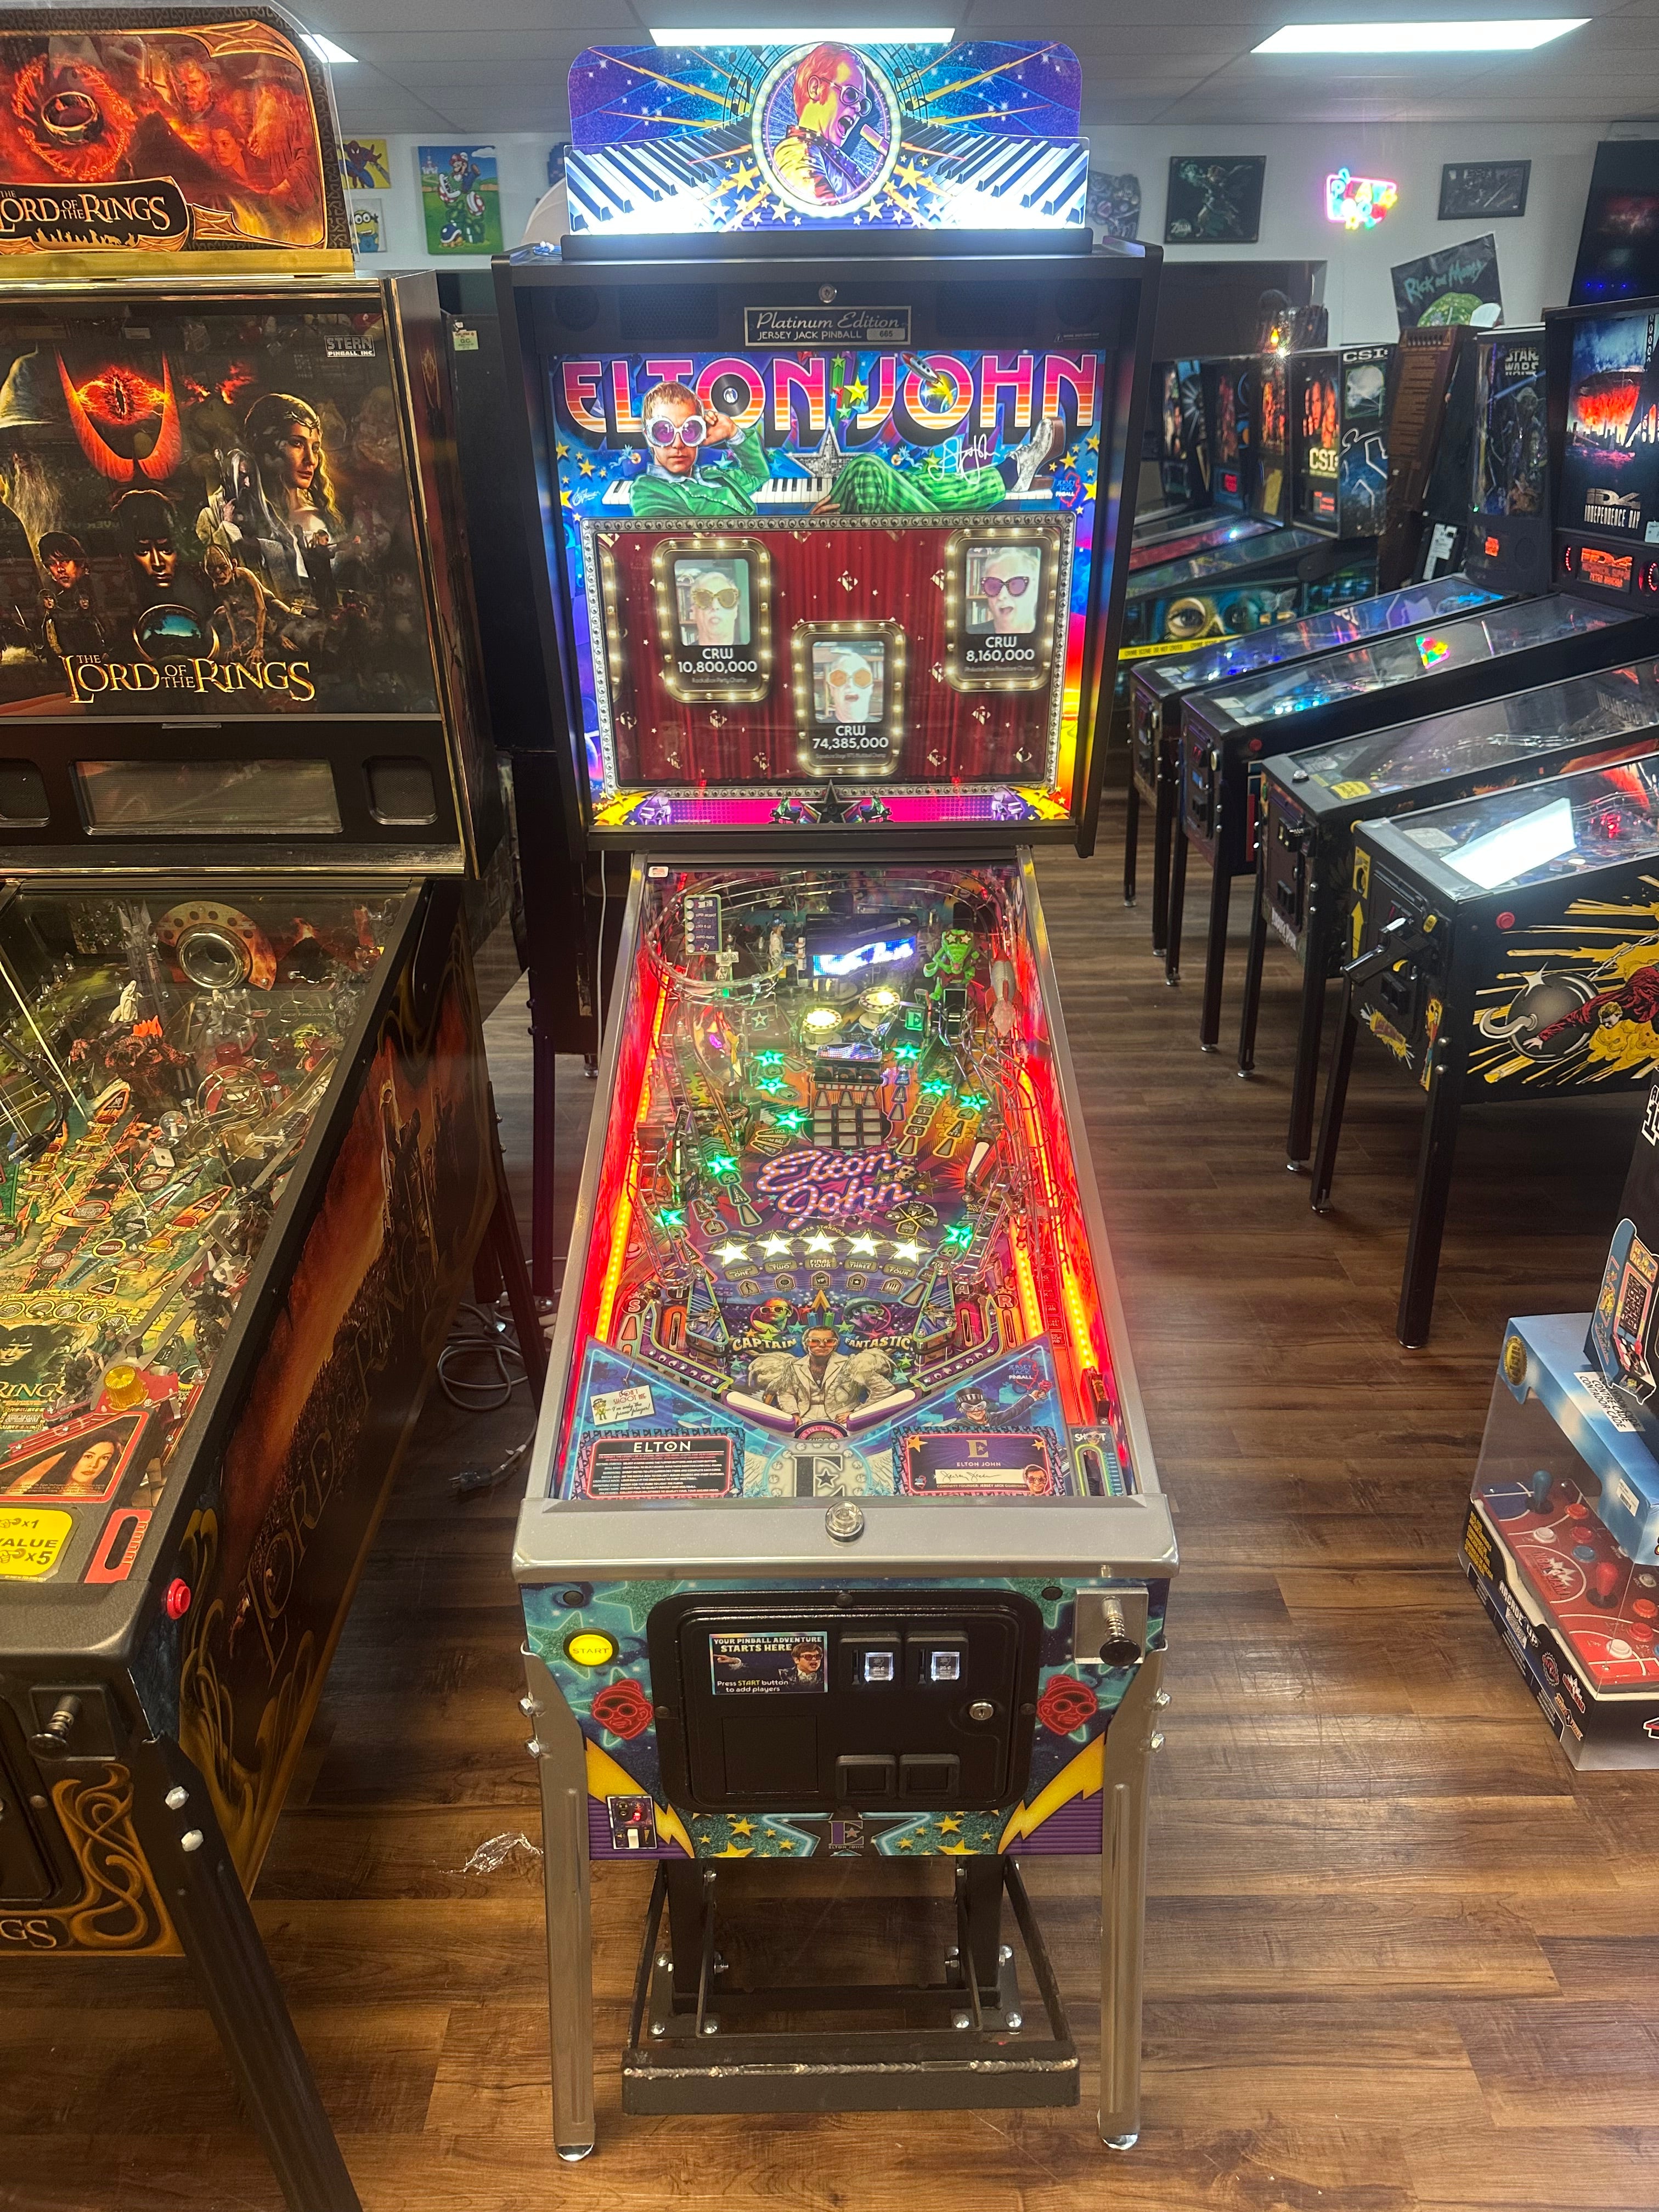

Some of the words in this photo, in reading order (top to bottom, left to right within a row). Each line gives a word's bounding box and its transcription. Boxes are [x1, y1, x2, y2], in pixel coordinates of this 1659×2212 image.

[61, 199, 77, 210] OF
[61, 209, 84, 219] THE
[78, 193, 171, 230] RINGS
[757, 312, 833, 329] Platinum
[837, 311, 899, 329] Edition
[757, 331, 791, 341] JERSEY
[793, 331, 819, 341] JACK
[821, 331, 862, 340] PINBALL
[326, 337, 373, 349] STERN
[1505, 346, 1539, 362] STAR
[562, 357, 826, 432] ELTON
[856, 354, 1097, 430] JOHN
[1584, 504, 1627, 527] INDEPENDENCE
[985, 636, 1017, 648] CRW
[76, 654, 101, 663] THE
[702, 648, 733, 659] CRW
[966, 649, 1035, 663] 8,160,000
[165, 664, 187, 676] OF
[678, 661, 758, 674] 10,800,000
[58, 655, 160, 703] LORD
[162, 676, 196, 689] THE
[187, 658, 315, 702] RINGS
[835, 725, 866, 736] CRW
[812, 737, 889, 750] 74,385,000
[757, 1149, 903, 1193] Elton
[777, 1178, 913, 1230] John
[628, 1300, 641, 1312] S
[997, 1295, 1013, 1307] R
[732, 1336, 797, 1351] CAPTAIN
[844, 1335, 912, 1350] FANTASTIC
[613, 1396, 636, 1405] SHOOT
[633, 1441, 691, 1453] ELTON
[966, 1440, 989, 1458] E
[22, 1519, 40, 1528] x1
[27, 1550, 53, 1565] x5
[720, 1644, 762, 1652] STARTS
[827, 1820, 865, 1846] E
